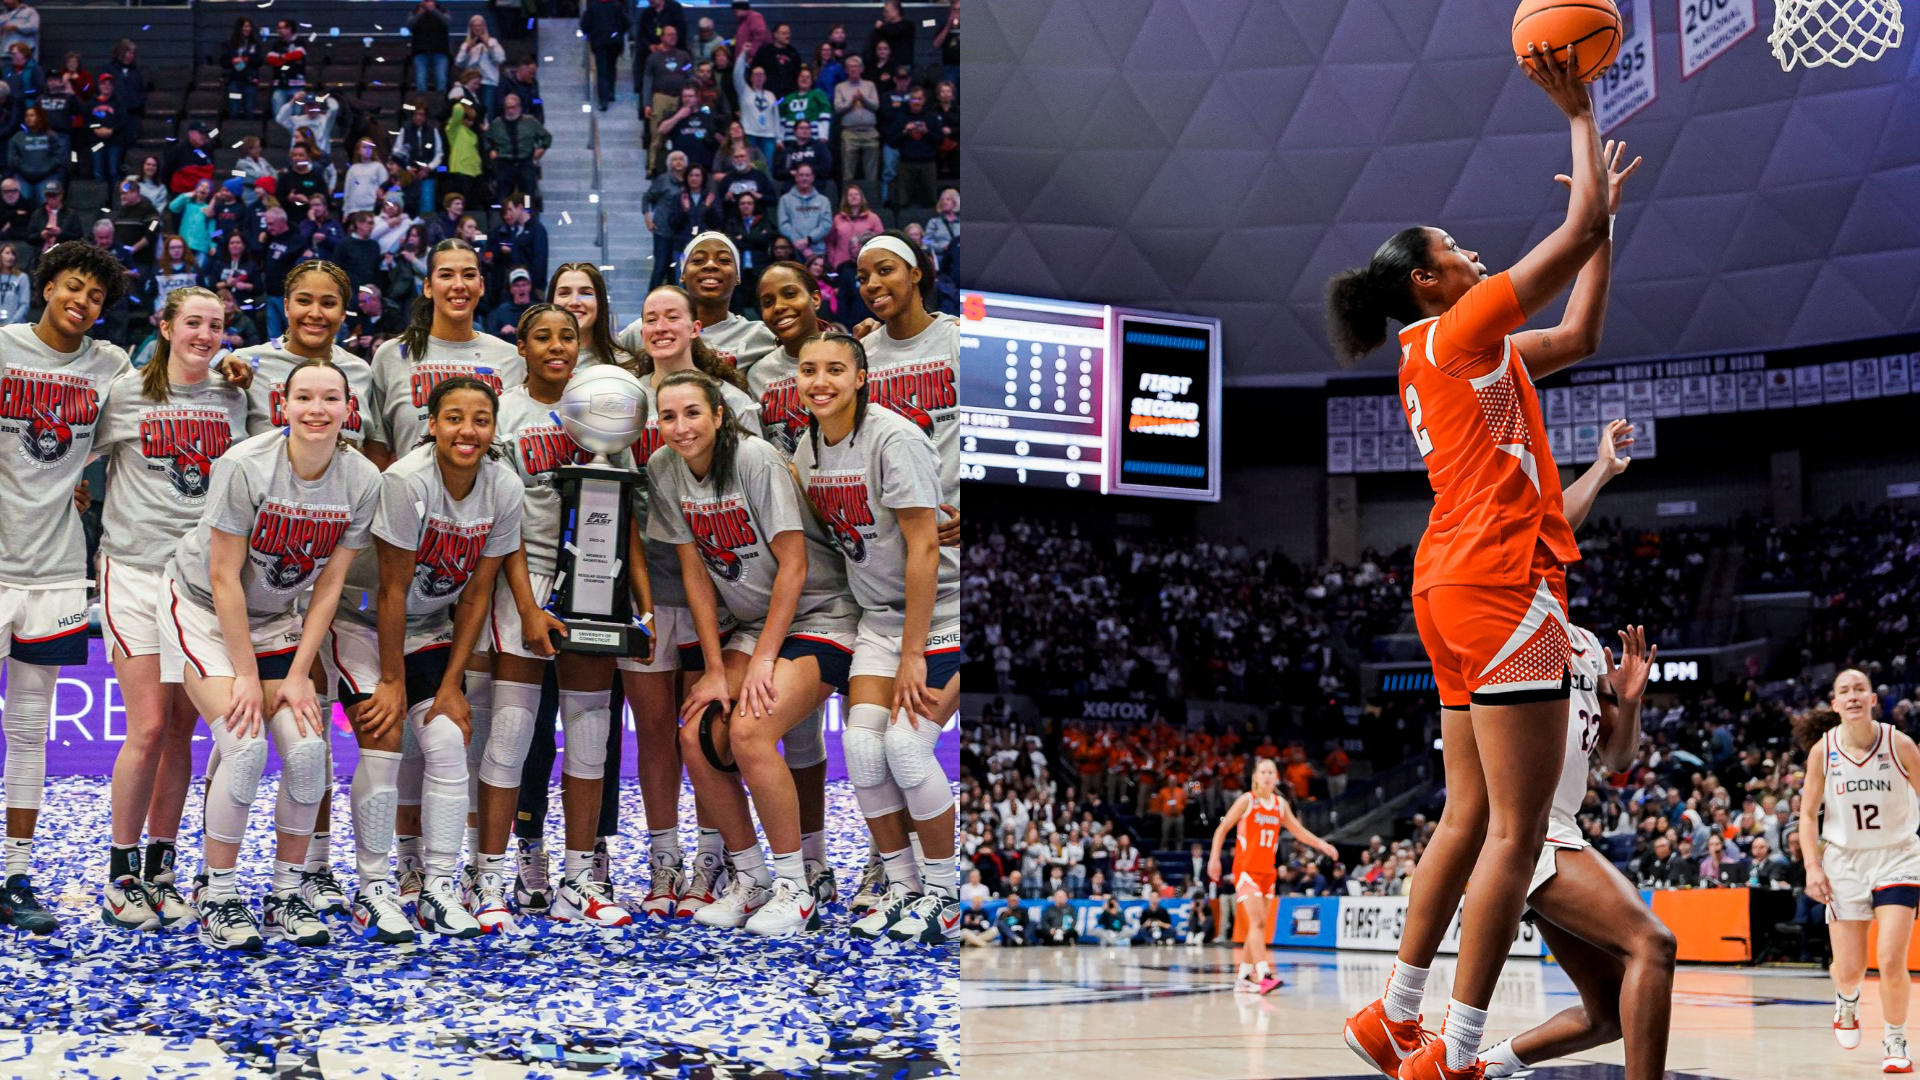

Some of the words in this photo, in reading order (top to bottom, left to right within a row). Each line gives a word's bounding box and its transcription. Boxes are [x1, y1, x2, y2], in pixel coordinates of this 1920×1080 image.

[1602, 41, 1645, 95] 1995
[10, 369, 53, 379] REGULAR
[868, 367, 905, 378] REGULAR
[910, 361, 945, 372] SEASON
[868, 367, 957, 411] HAMPIONS
[1139, 373, 1192, 395] FIRST
[0, 377, 99, 426] CHAMPIONS
[1131, 397, 1199, 420] SECOND
[146, 411, 188, 419] REGULAR
[193, 411, 224, 420] SEASON
[936, 413, 955, 422] 2026
[971, 413, 1009, 428] STATS
[1405, 383, 1434, 457] 2
[140, 419, 233, 459] CHAMPIONS
[964, 436, 977, 452] 2
[1015, 441, 1030, 456] 0
[1066, 445, 1081, 460] 0
[1017, 467, 1027, 483] 1
[1066, 472, 1080, 488] 0
[302, 503, 351, 511] CONFERENC
[702, 501, 736, 512] SEASON
[684, 508, 757, 550] MPIONS
[926, 634, 960, 646] USKIE
[1663, 662, 1698, 682] PM
[1083, 701, 1148, 719] xerox
[1836, 779, 1891, 795] UCONN
[1852, 804, 1881, 830] 12
[1259, 829, 1275, 847] 17
[1343, 907, 1381, 938] FIRST
